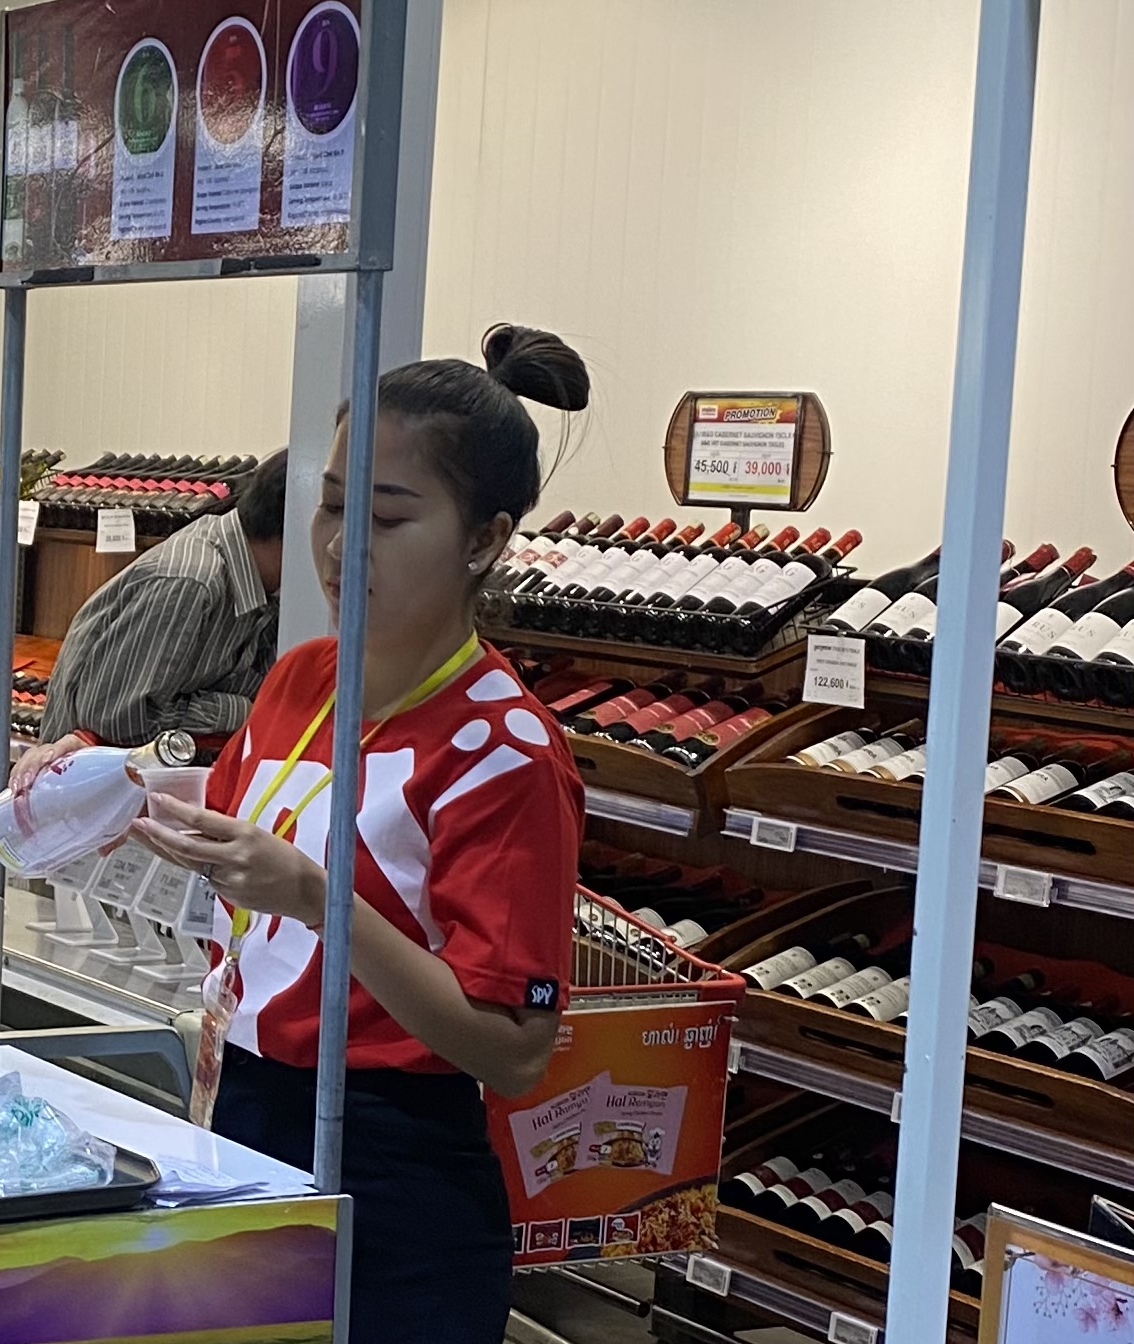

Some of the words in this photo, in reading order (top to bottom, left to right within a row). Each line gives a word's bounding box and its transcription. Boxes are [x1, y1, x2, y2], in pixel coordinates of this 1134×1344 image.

[725, 407, 776, 421] PROMOTION
[695, 459, 729, 474] 45,500
[745, 461, 782, 476] 39,000
[530, 984, 554, 1005] SPY
[606, 1095, 628, 1108] Hal
[532, 1110, 554, 1131] Hal
